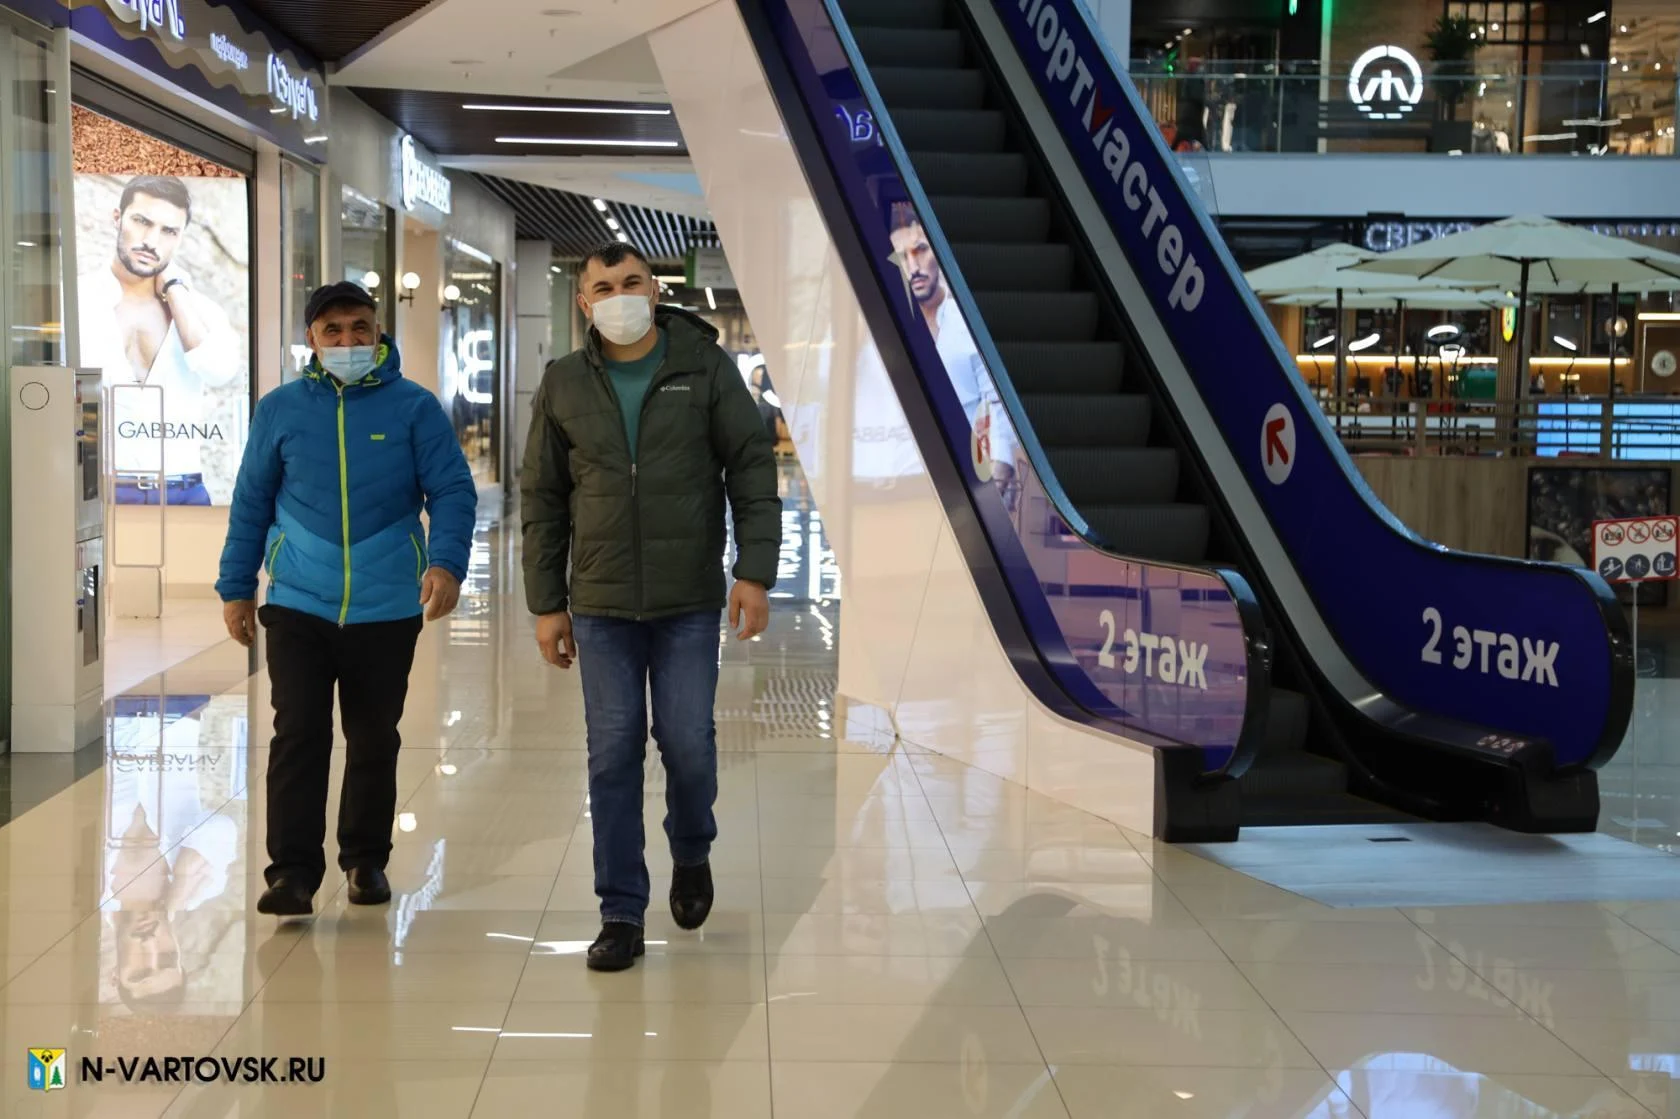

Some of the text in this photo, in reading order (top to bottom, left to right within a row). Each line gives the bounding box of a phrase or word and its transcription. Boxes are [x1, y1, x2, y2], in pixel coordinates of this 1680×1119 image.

[118, 421, 223, 440] GABBANA
[1098, 609, 1209, 689] 2 этаж
[1421, 607, 1560, 687] 2 этаж
